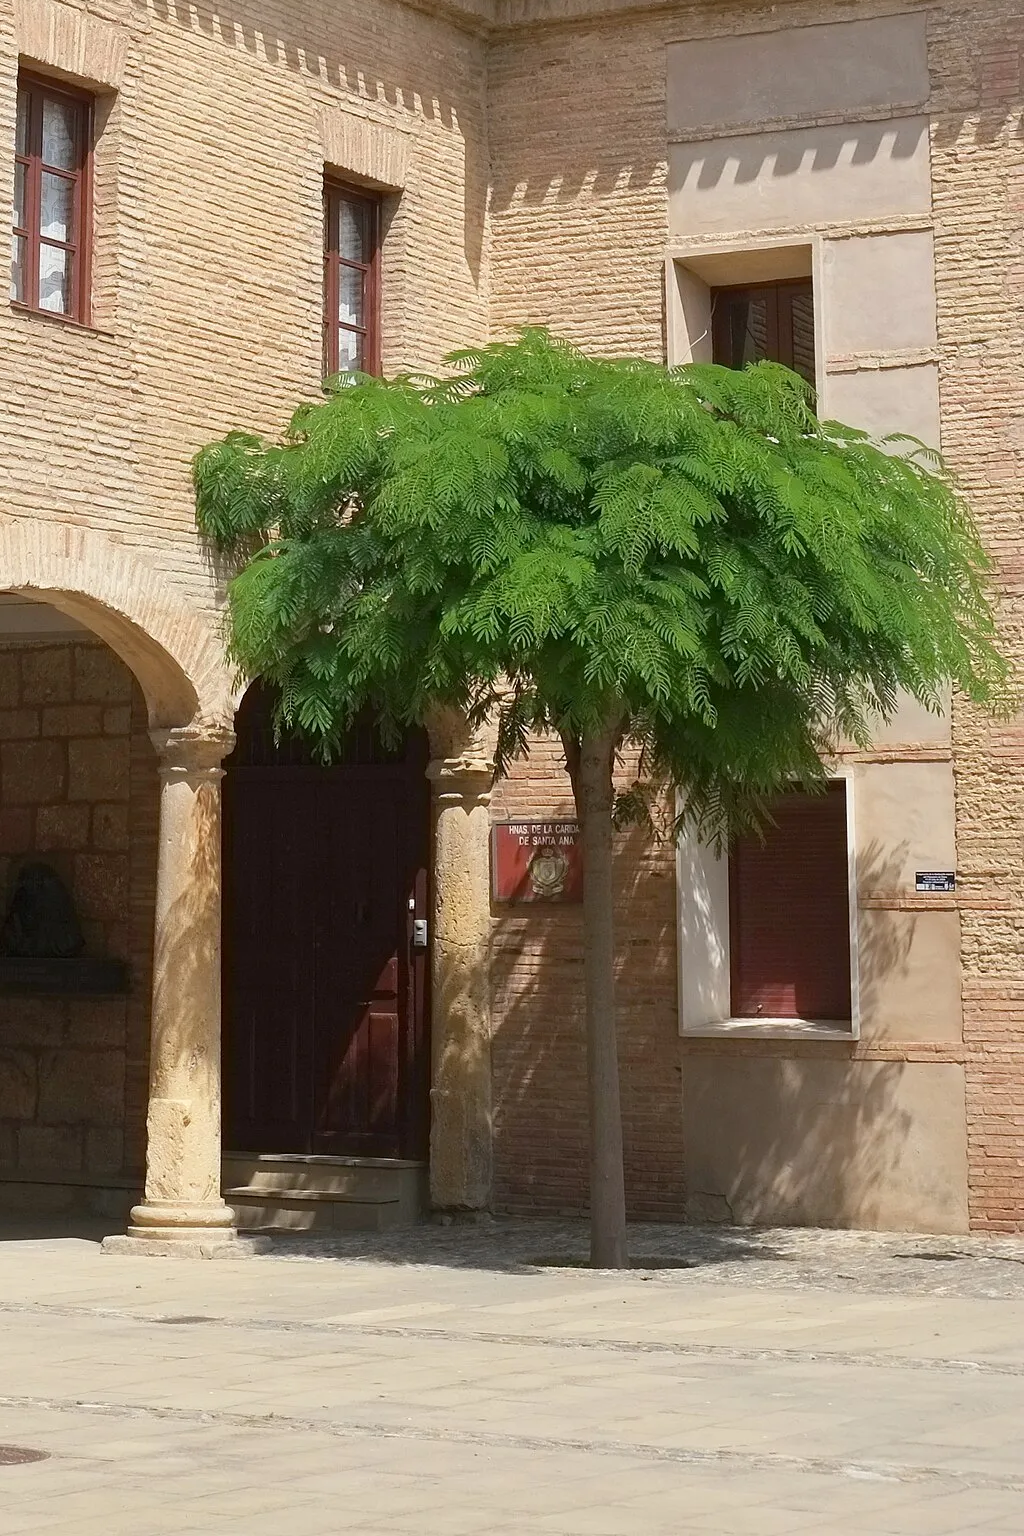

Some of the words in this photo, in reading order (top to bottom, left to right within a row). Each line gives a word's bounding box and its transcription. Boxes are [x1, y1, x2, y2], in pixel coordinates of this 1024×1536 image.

[509, 825, 529, 834] HNAS.
[532, 825, 541, 834] DE
[544, 825, 552, 834] LA
[555, 825, 580, 834] CARIDA
[519, 837, 529, 845] DE
[533, 837, 556, 845] SANTA
[559, 837, 574, 845] ANA
